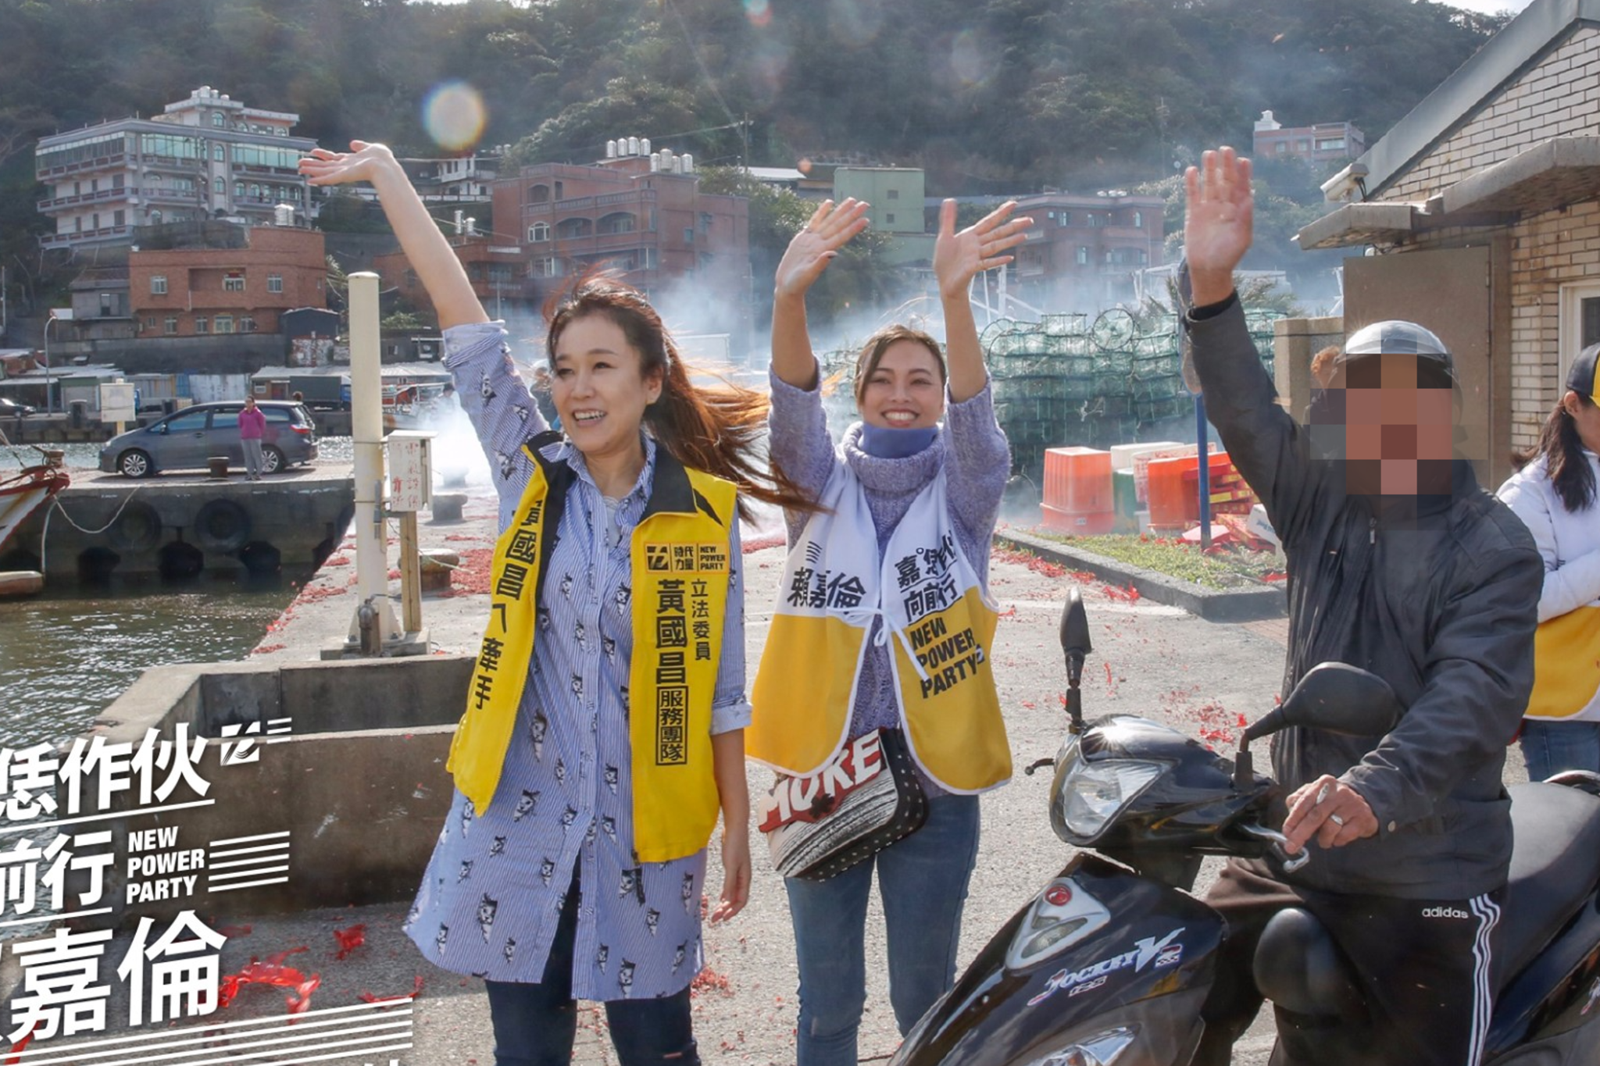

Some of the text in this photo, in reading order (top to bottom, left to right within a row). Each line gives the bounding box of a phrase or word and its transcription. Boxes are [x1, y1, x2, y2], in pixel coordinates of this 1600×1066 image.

[691, 578, 711, 660] 立法委員
[904, 574, 957, 622] 向前行
[910, 617, 947, 650] NEW
[916, 627, 976, 669] POWER
[656, 579, 687, 762] 黃國昌 服務團隊
[920, 655, 977, 699] PARTY
[1422, 907, 1468, 919] adidas
